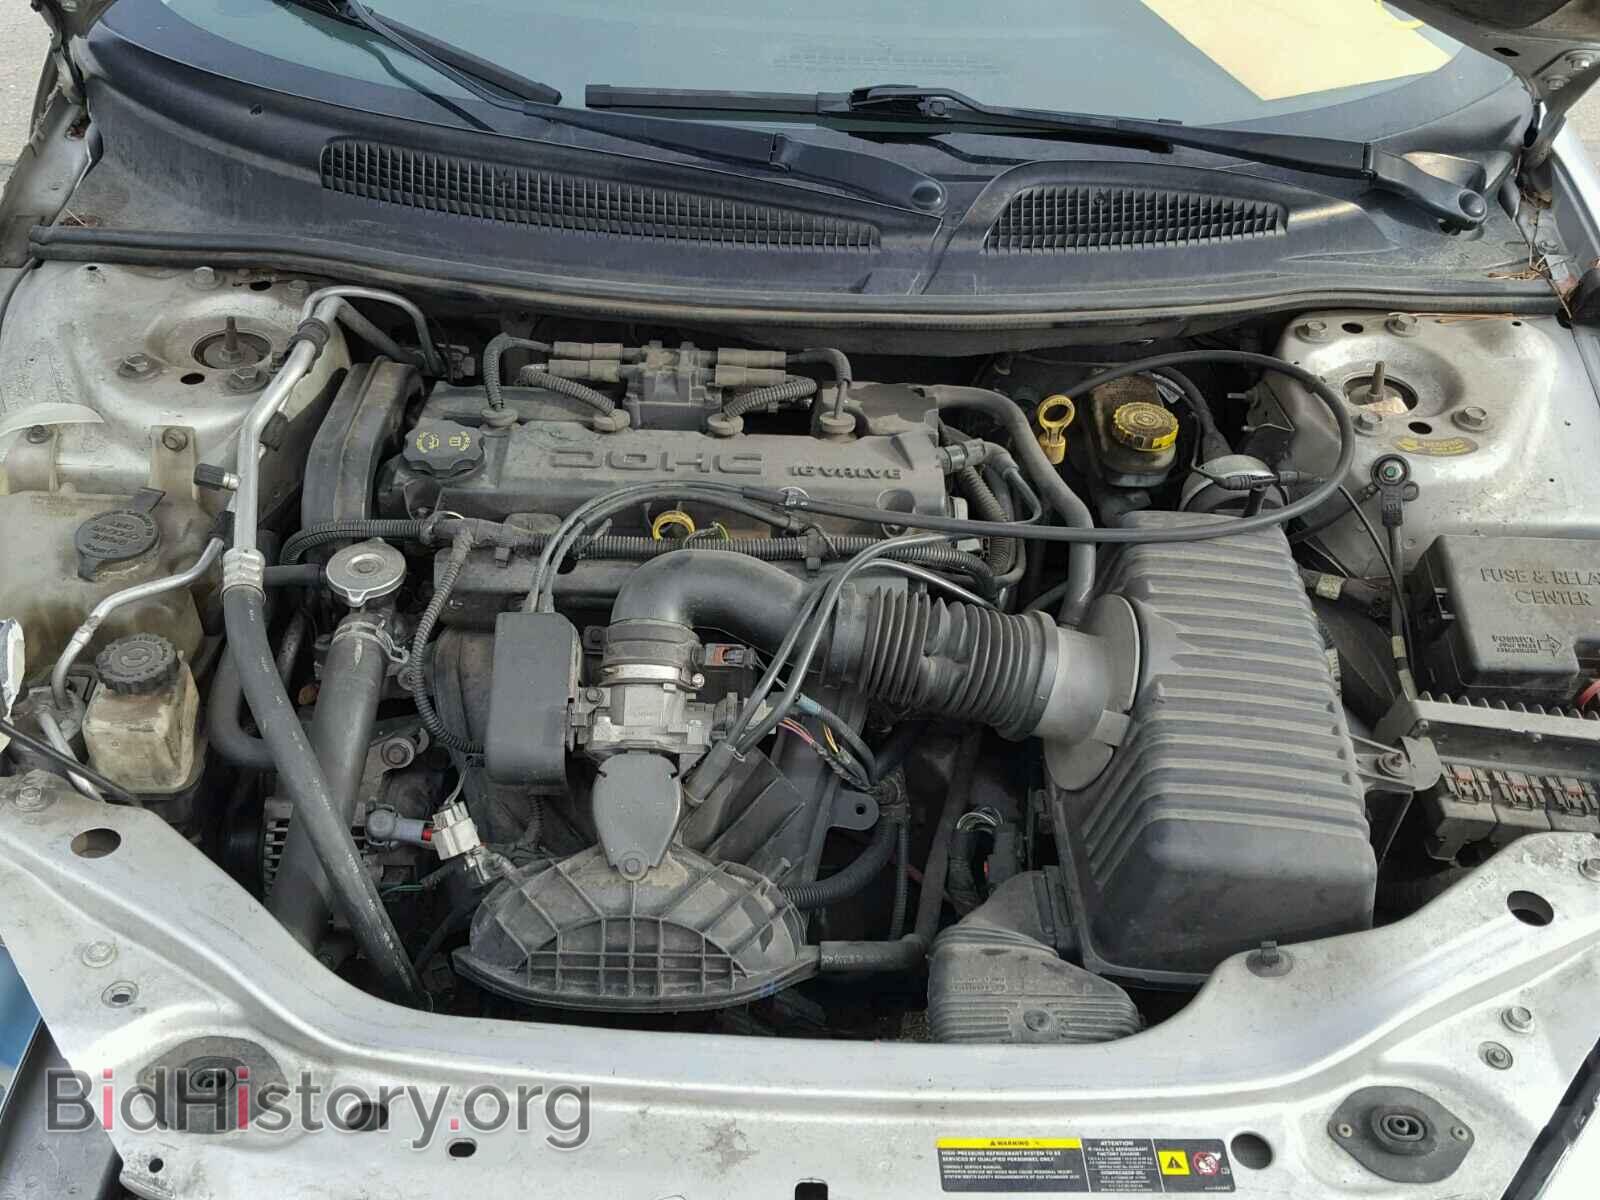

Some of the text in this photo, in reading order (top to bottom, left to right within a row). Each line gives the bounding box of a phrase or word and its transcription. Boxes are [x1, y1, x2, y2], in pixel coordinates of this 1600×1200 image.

[550, 450, 763, 475] DOHC
[1480, 566, 1529, 582] FUSE
[1533, 569, 1548, 584] &
[1515, 590, 1592, 607] CENTER
